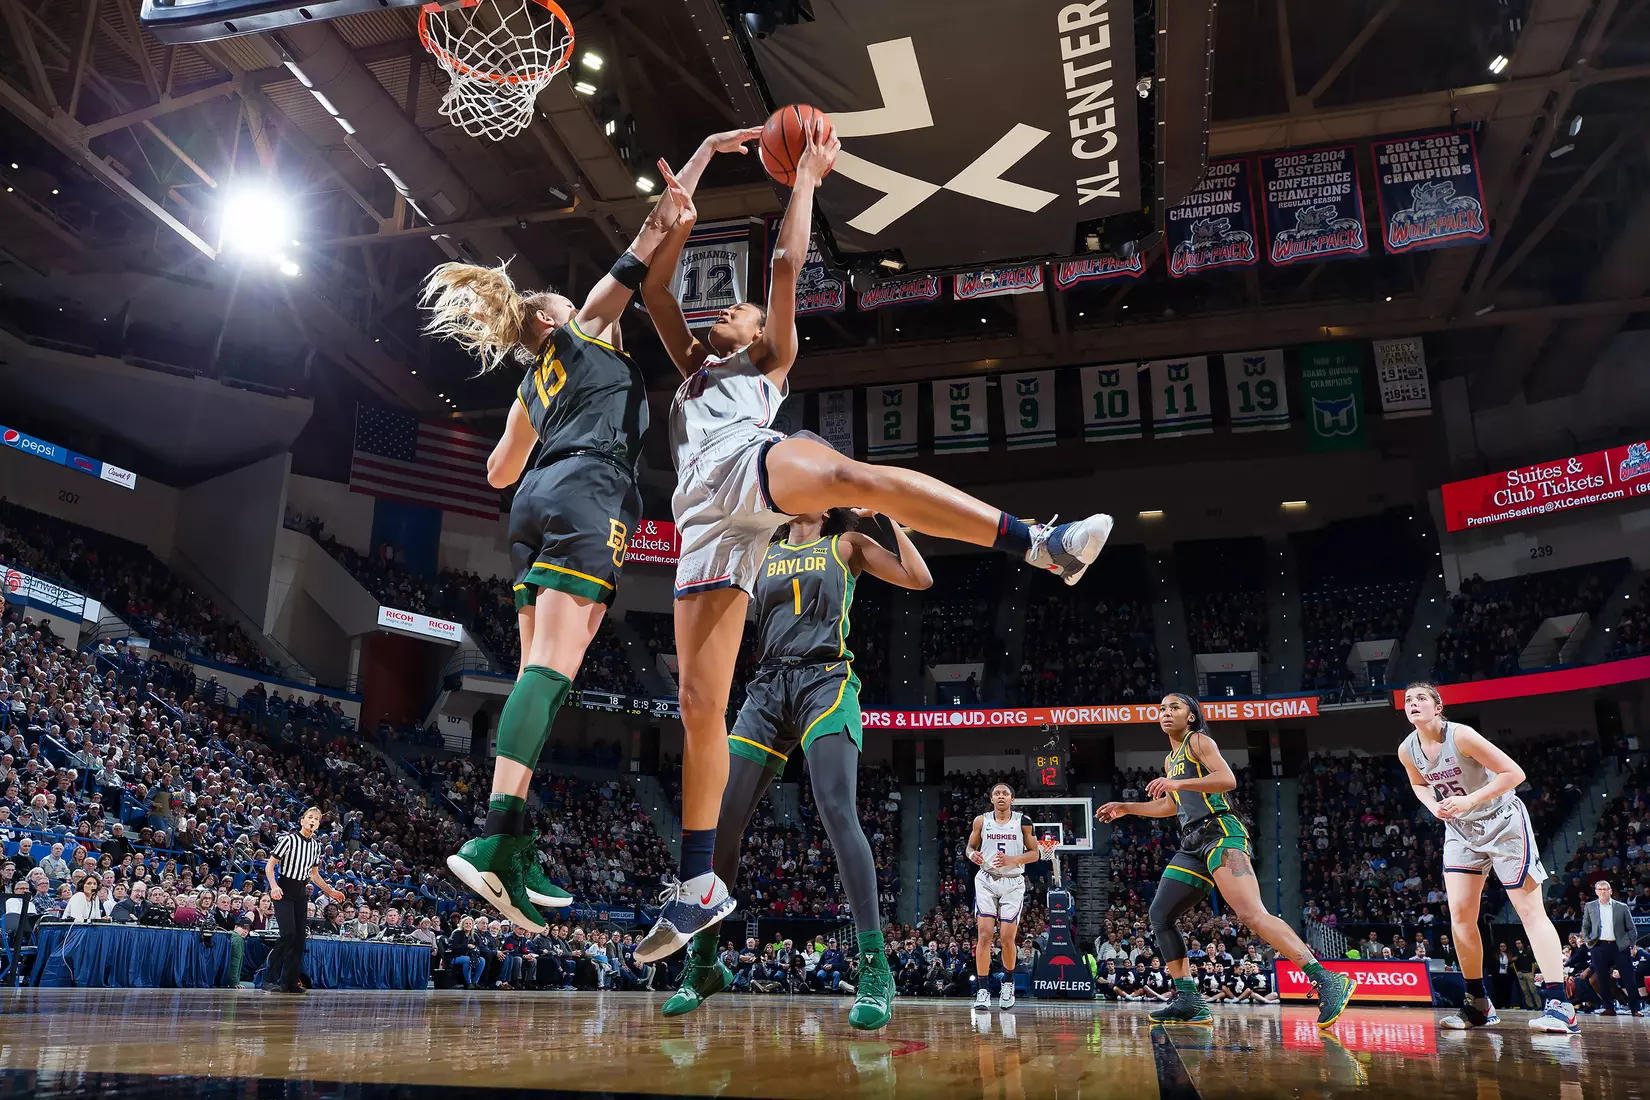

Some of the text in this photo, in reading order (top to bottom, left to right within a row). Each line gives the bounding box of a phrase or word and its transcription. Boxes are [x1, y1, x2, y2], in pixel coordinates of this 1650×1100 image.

[1057, 0, 1120, 206] XL CENTER
[1386, 135, 1461, 154] 2014-2015
[1274, 149, 1346, 168] 2003-2004
[1380, 144, 1469, 165] NORTHEAST
[1278, 161, 1342, 178] EASTERN
[1392, 155, 1459, 173] DIVISION
[1268, 172, 1351, 190] CONFERENCE
[1383, 164, 1472, 184] CHAMPIONS
[1194, 176, 1236, 192] ANTIC
[1269, 183, 1351, 202] CHAMPIONS
[1170, 202, 1241, 221] CHAMPIONS
[1278, 196, 1342, 209] REGULAR SEASON
[681, 250, 738, 267] GERNANDER
[682, 264, 735, 303] 12
[1382, 355, 1419, 366] FAMILY
[1329, 366, 1359, 377] DIVISION
[1310, 377, 1353, 389] CHAMPIONS
[1093, 389, 1130, 420] 10
[1164, 383, 1198, 415] 11
[1237, 379, 1279, 413] 19
[950, 403, 972, 433] 5
[1019, 397, 1039, 429] 9
[883, 410, 902, 441] 2
[21, 438, 56, 457] pepsi
[1507, 457, 1583, 487] Suites &
[58, 489, 81, 505] 207
[1493, 474, 1604, 507] Club Tickets
[1467, 489, 1624, 527] PremiumSeating@XLCenter.com
[630, 535, 670, 551] ickets
[1530, 545, 1554, 559] 239
[766, 556, 827, 578] BAYLOR
[792, 578, 802, 615] 1
[385, 611, 414, 623] RICOH
[428, 620, 455, 632] RICOH
[173, 650, 187, 660] 106
[608, 696, 669, 711] 18 8:19 20
[446, 715, 462, 724] 107
[895, 714, 907, 726] &
[910, 710, 1028, 727] LIVELOUD.ORG
[1050, 707, 1131, 723] WORKING
[1203, 703, 1239, 719] THE
[1242, 699, 1312, 717] STIGMA
[1037, 756, 1059, 767] 8:19
[1041, 767, 1057, 786] 12
[986, 833, 1017, 841] HUSKIES
[996, 843, 1006, 854] 5
[1033, 980, 1092, 991] TRAVELERS
[1354, 971, 1418, 986] FARGO
